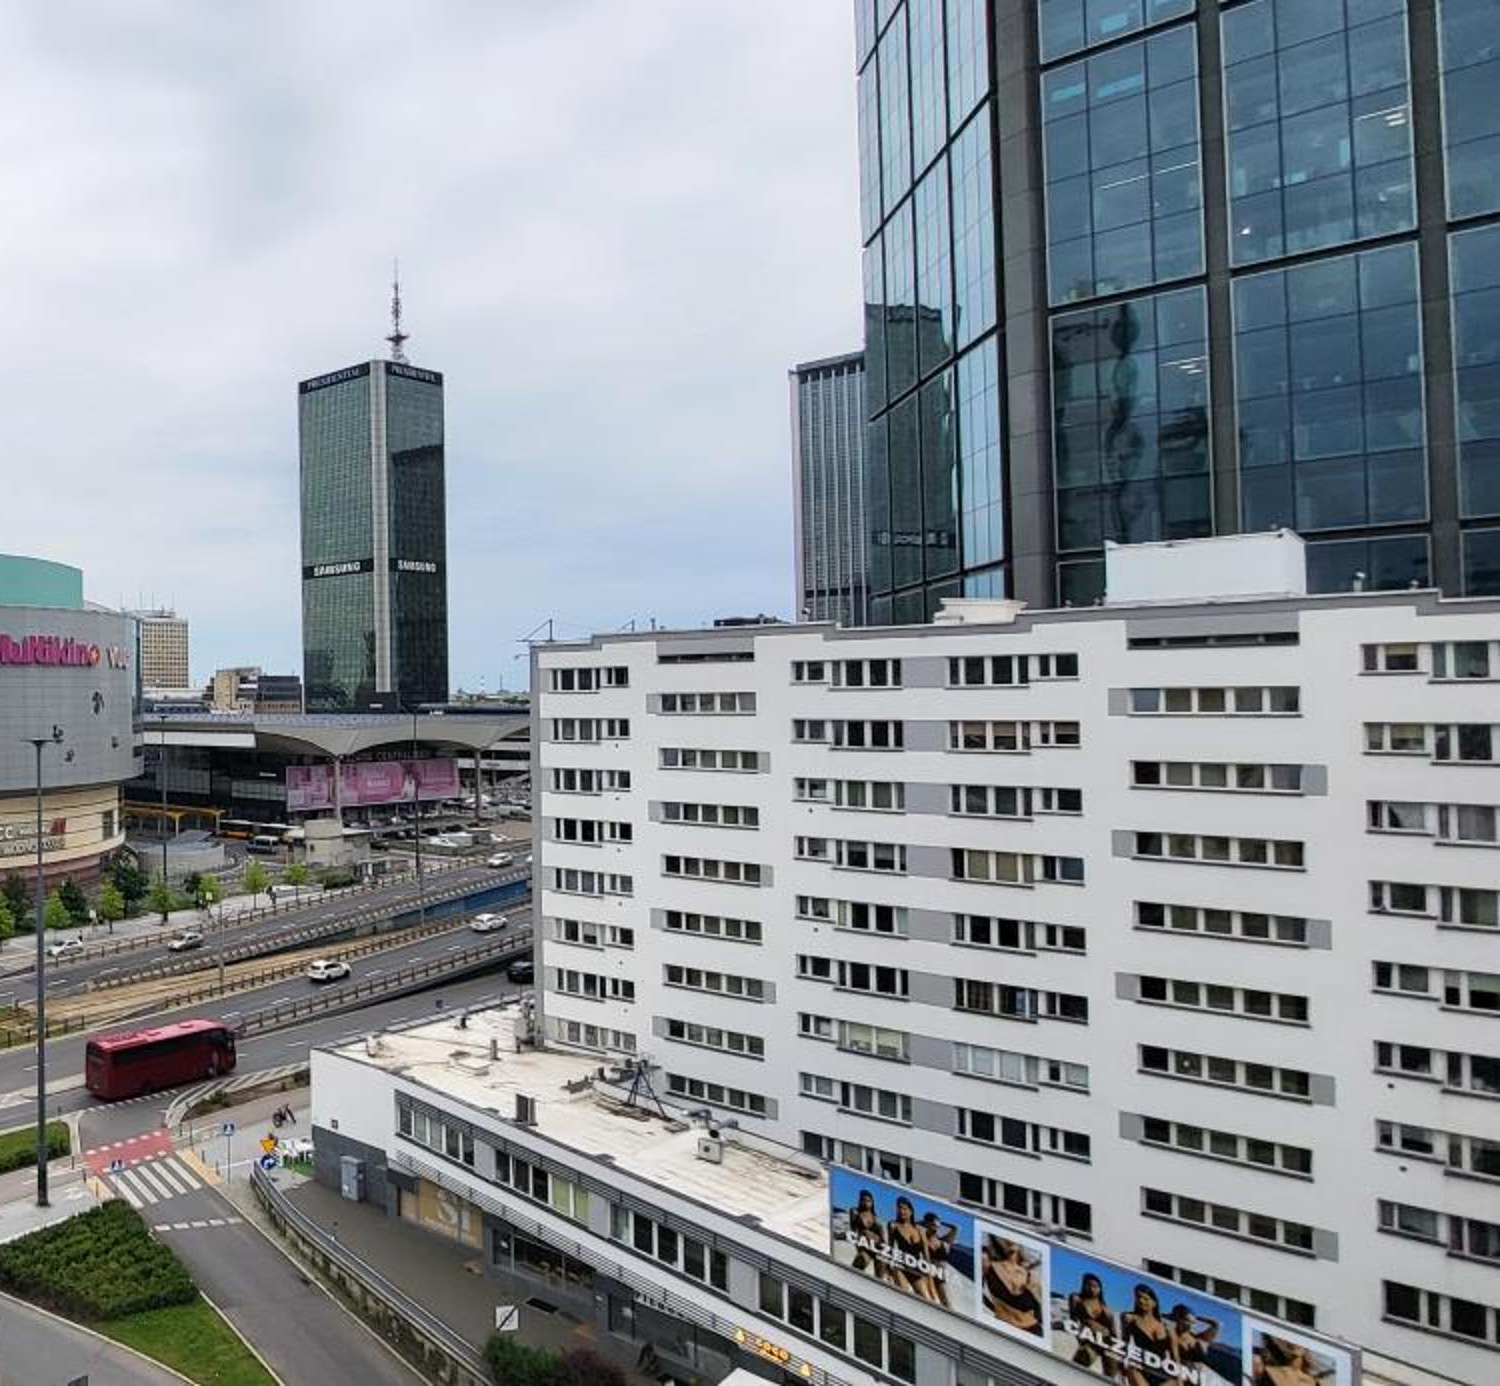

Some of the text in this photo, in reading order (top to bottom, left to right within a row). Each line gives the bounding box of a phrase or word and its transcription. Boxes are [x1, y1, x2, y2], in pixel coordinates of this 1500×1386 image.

[313, 561, 361, 577] SAMSUNG
[397, 560, 437, 573] SAMSUNG
[845, 1230, 950, 1282] CALZEDON
[1063, 1317, 1204, 1386] CALZEDON
